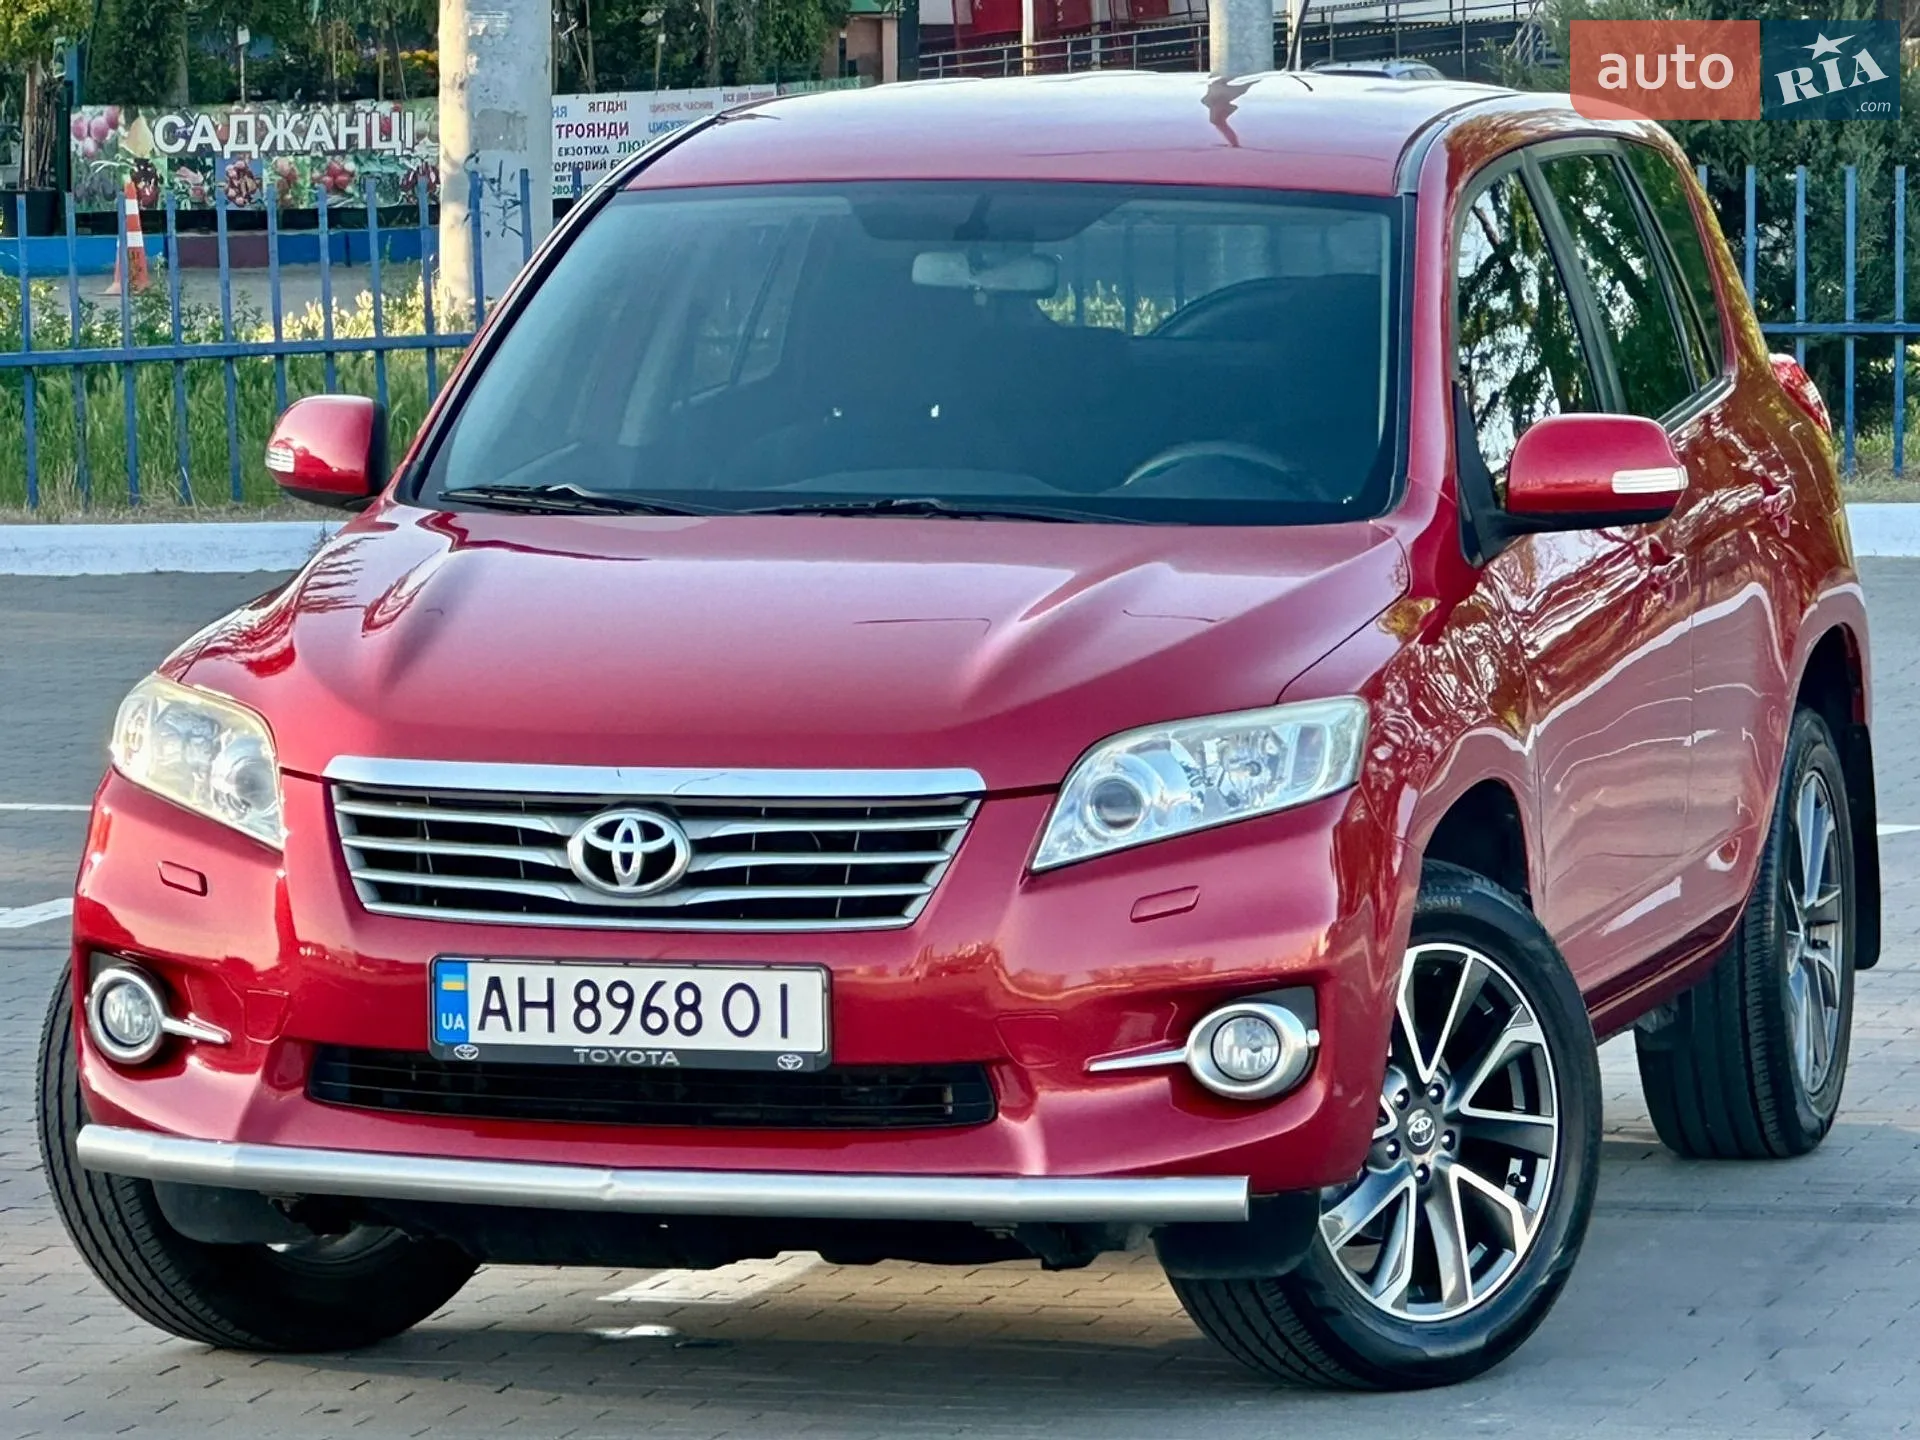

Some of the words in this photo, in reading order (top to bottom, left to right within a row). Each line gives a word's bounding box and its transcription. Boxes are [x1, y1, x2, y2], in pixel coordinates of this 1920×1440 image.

[552, 105, 568, 118] НЯ
[153, 112, 414, 158] САДЖАНЦІ
[555, 121, 629, 140] ТРОЯНДИ
[557, 144, 610, 157] ЕКЗОТИКА
[553, 158, 607, 172] ОРМОВИЙ
[478, 975, 556, 1033] AH
[573, 978, 703, 1037] 8968
[721, 982, 789, 1039] OI
[441, 1012, 466, 1031] UA
[573, 1047, 681, 1066] TOYOTA
